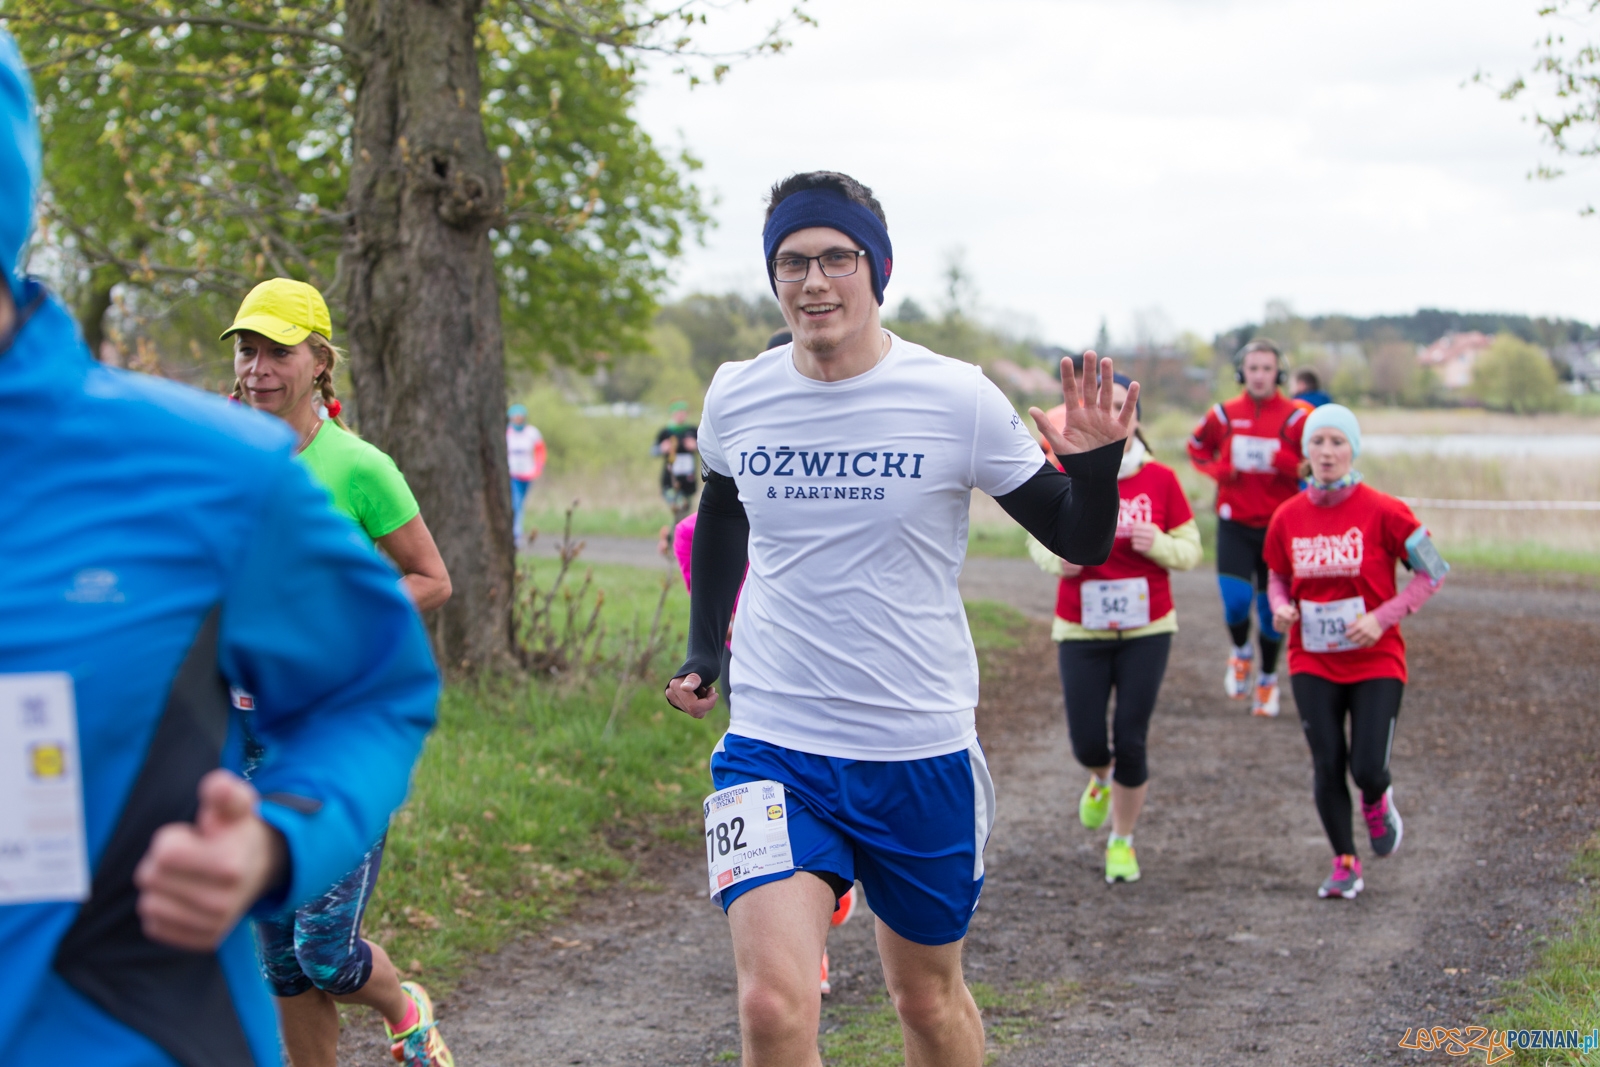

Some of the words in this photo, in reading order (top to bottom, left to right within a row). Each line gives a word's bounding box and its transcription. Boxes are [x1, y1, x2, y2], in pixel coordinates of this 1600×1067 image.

[766, 486, 778, 499] &
[784, 486, 885, 501] PARTNERS
[1101, 597, 1129, 614] 542
[1317, 617, 1347, 635] 733
[707, 816, 748, 863] 782
[743, 846, 767, 860] 10KM
